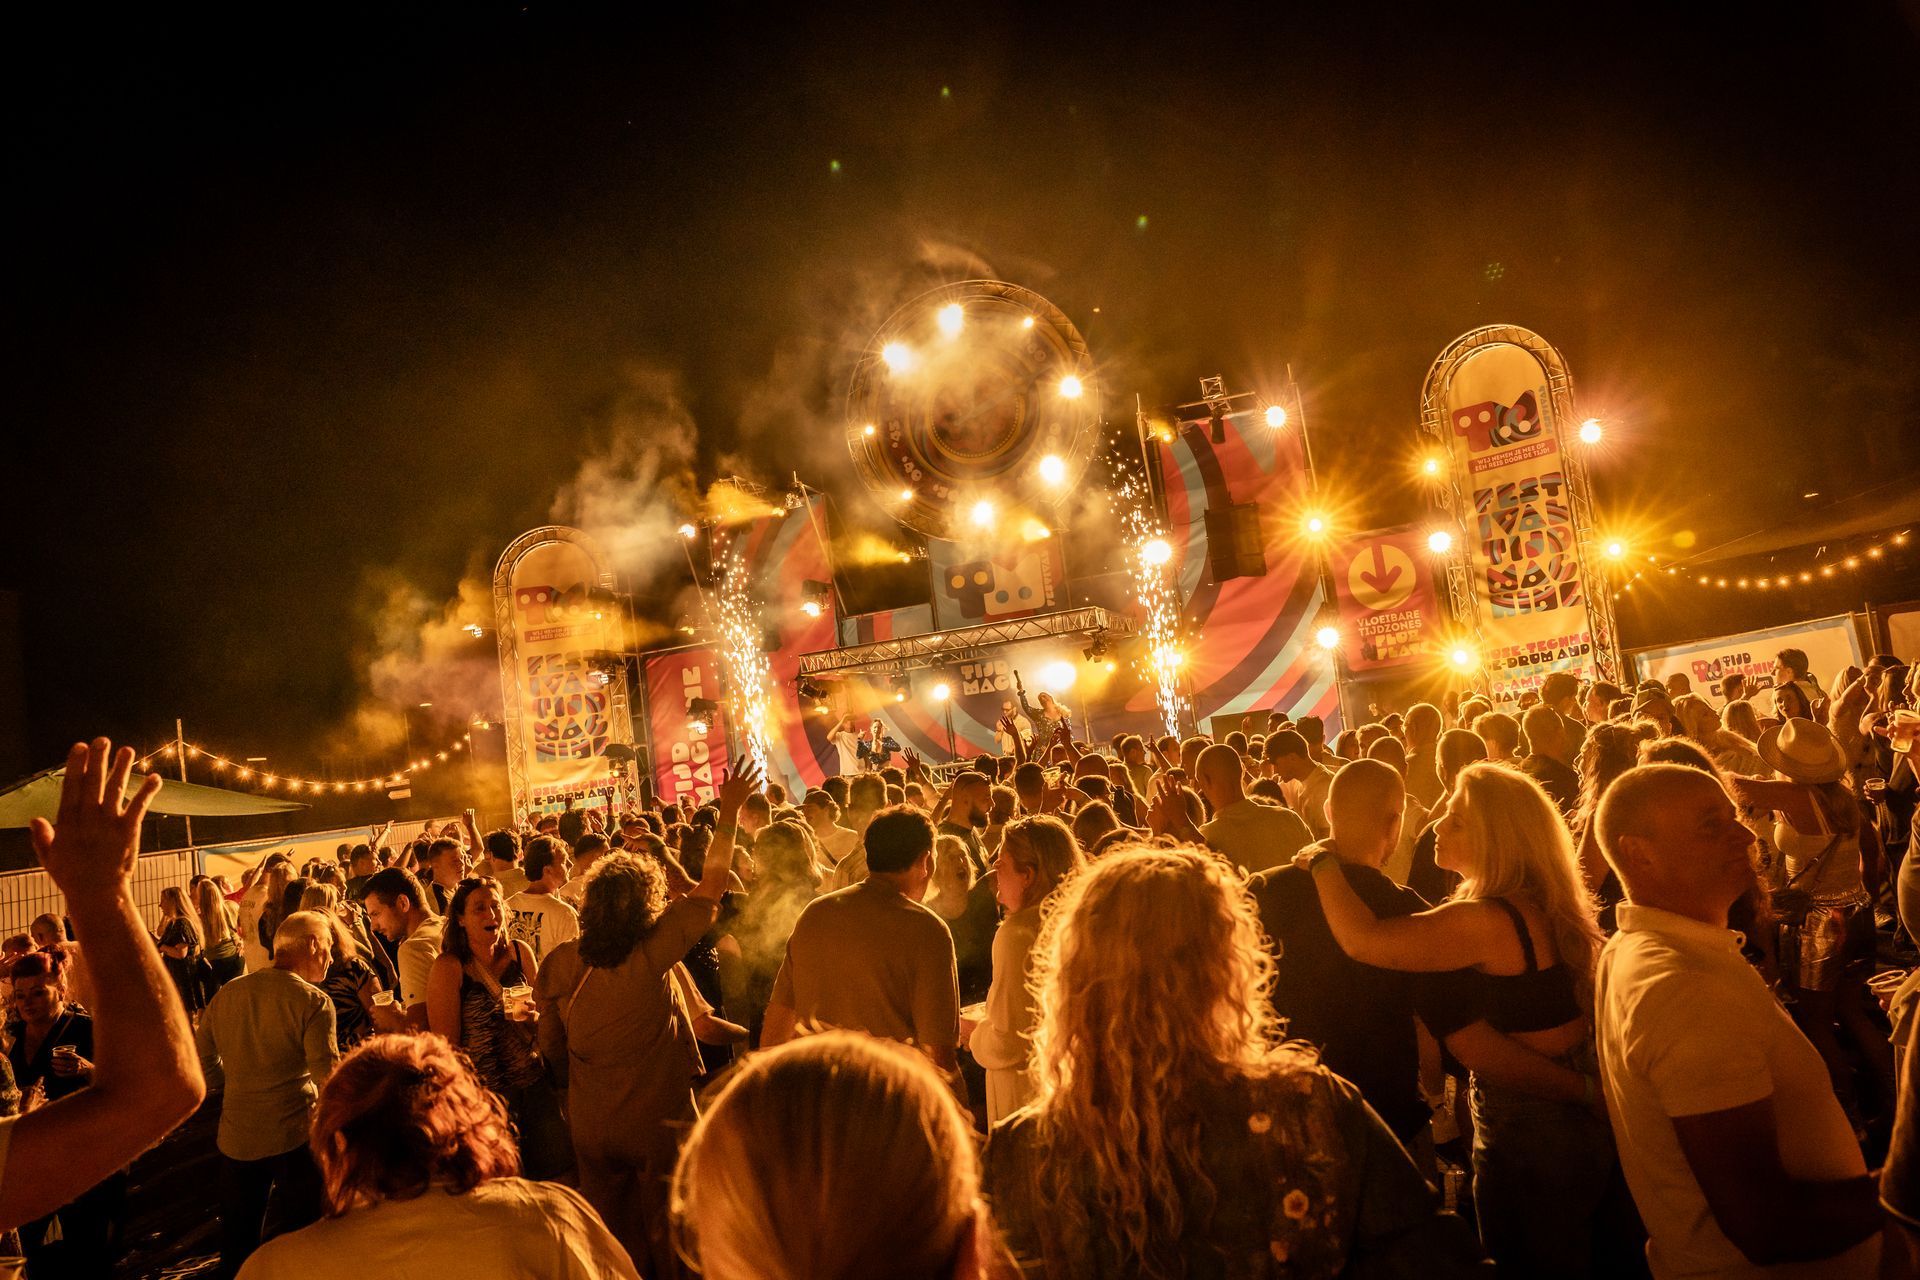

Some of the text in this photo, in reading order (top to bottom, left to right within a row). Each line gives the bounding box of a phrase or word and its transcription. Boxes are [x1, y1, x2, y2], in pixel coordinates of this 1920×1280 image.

[1475, 464, 1488, 472] EEN
[1488, 460, 1504, 469] REIS
[1504, 455, 1523, 464] DOOR
[1491, 451, 1513, 462] NEMEN
[1522, 445, 1535, 453] MEE
[1536, 442, 1546, 450] OP
[1473, 471, 1562, 514] FEST
[1477, 499, 1569, 541] IVAL
[1482, 526, 1572, 565] TIJD
[1487, 553, 1577, 594] MAC
[1489, 580, 1584, 619] HINE
[1357, 609, 1420, 627] VLOEIBARE
[1358, 619, 1422, 637] TIJDZONES
[961, 660, 1009, 680] TIJD
[1490, 643, 1590, 671] E-DRUM AND
[1722, 652, 1751, 667] TIJD
[1725, 661, 1775, 676] MACHIN
[532, 692, 606, 719] TIJD
[534, 714, 608, 742] MAC
